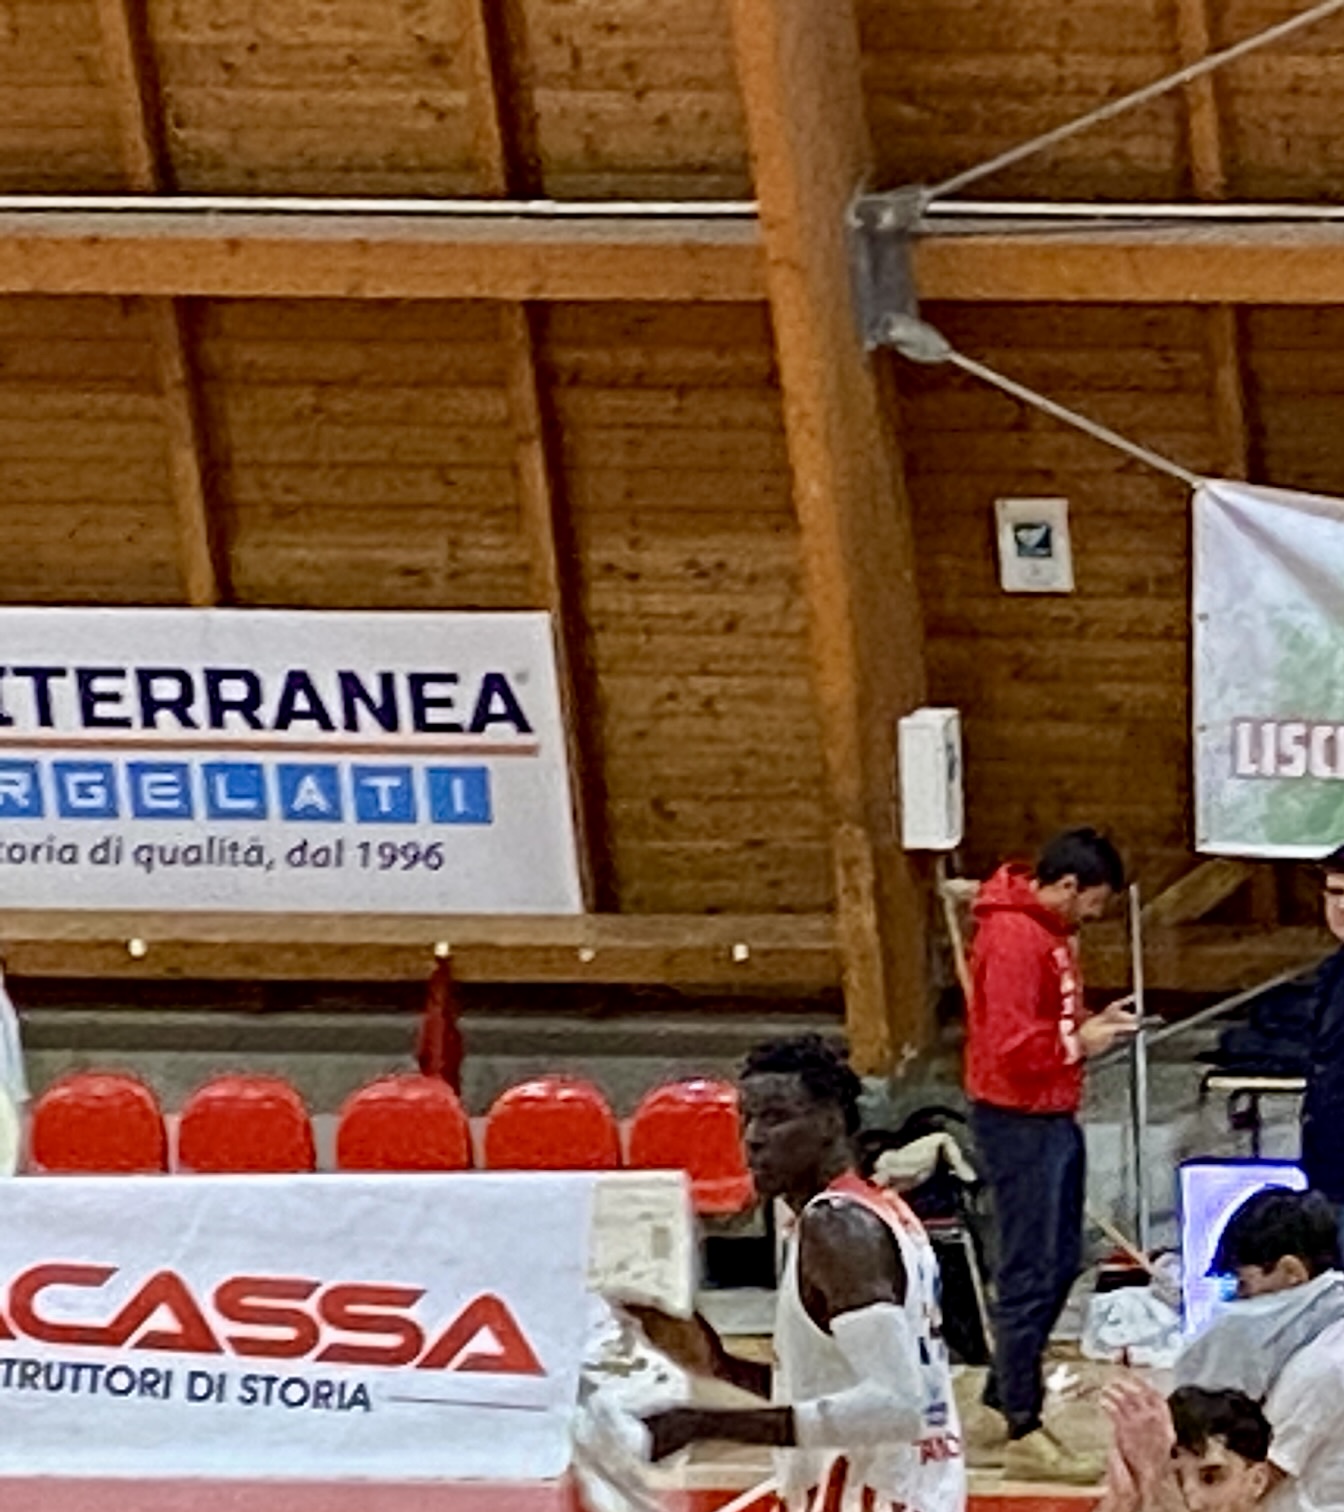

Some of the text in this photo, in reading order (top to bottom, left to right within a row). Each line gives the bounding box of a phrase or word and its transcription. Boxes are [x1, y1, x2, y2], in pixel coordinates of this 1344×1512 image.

[0, 666, 533, 734] TERRANEA
[0, 834, 79, 865] oria
[89, 836, 123, 865] di
[285, 838, 345, 868] dal
[357, 841, 445, 871] 1996
[0, 1263, 547, 1376] CASSA
[186, 1370, 227, 1403] DI
[238, 1374, 372, 1412] STORIA
